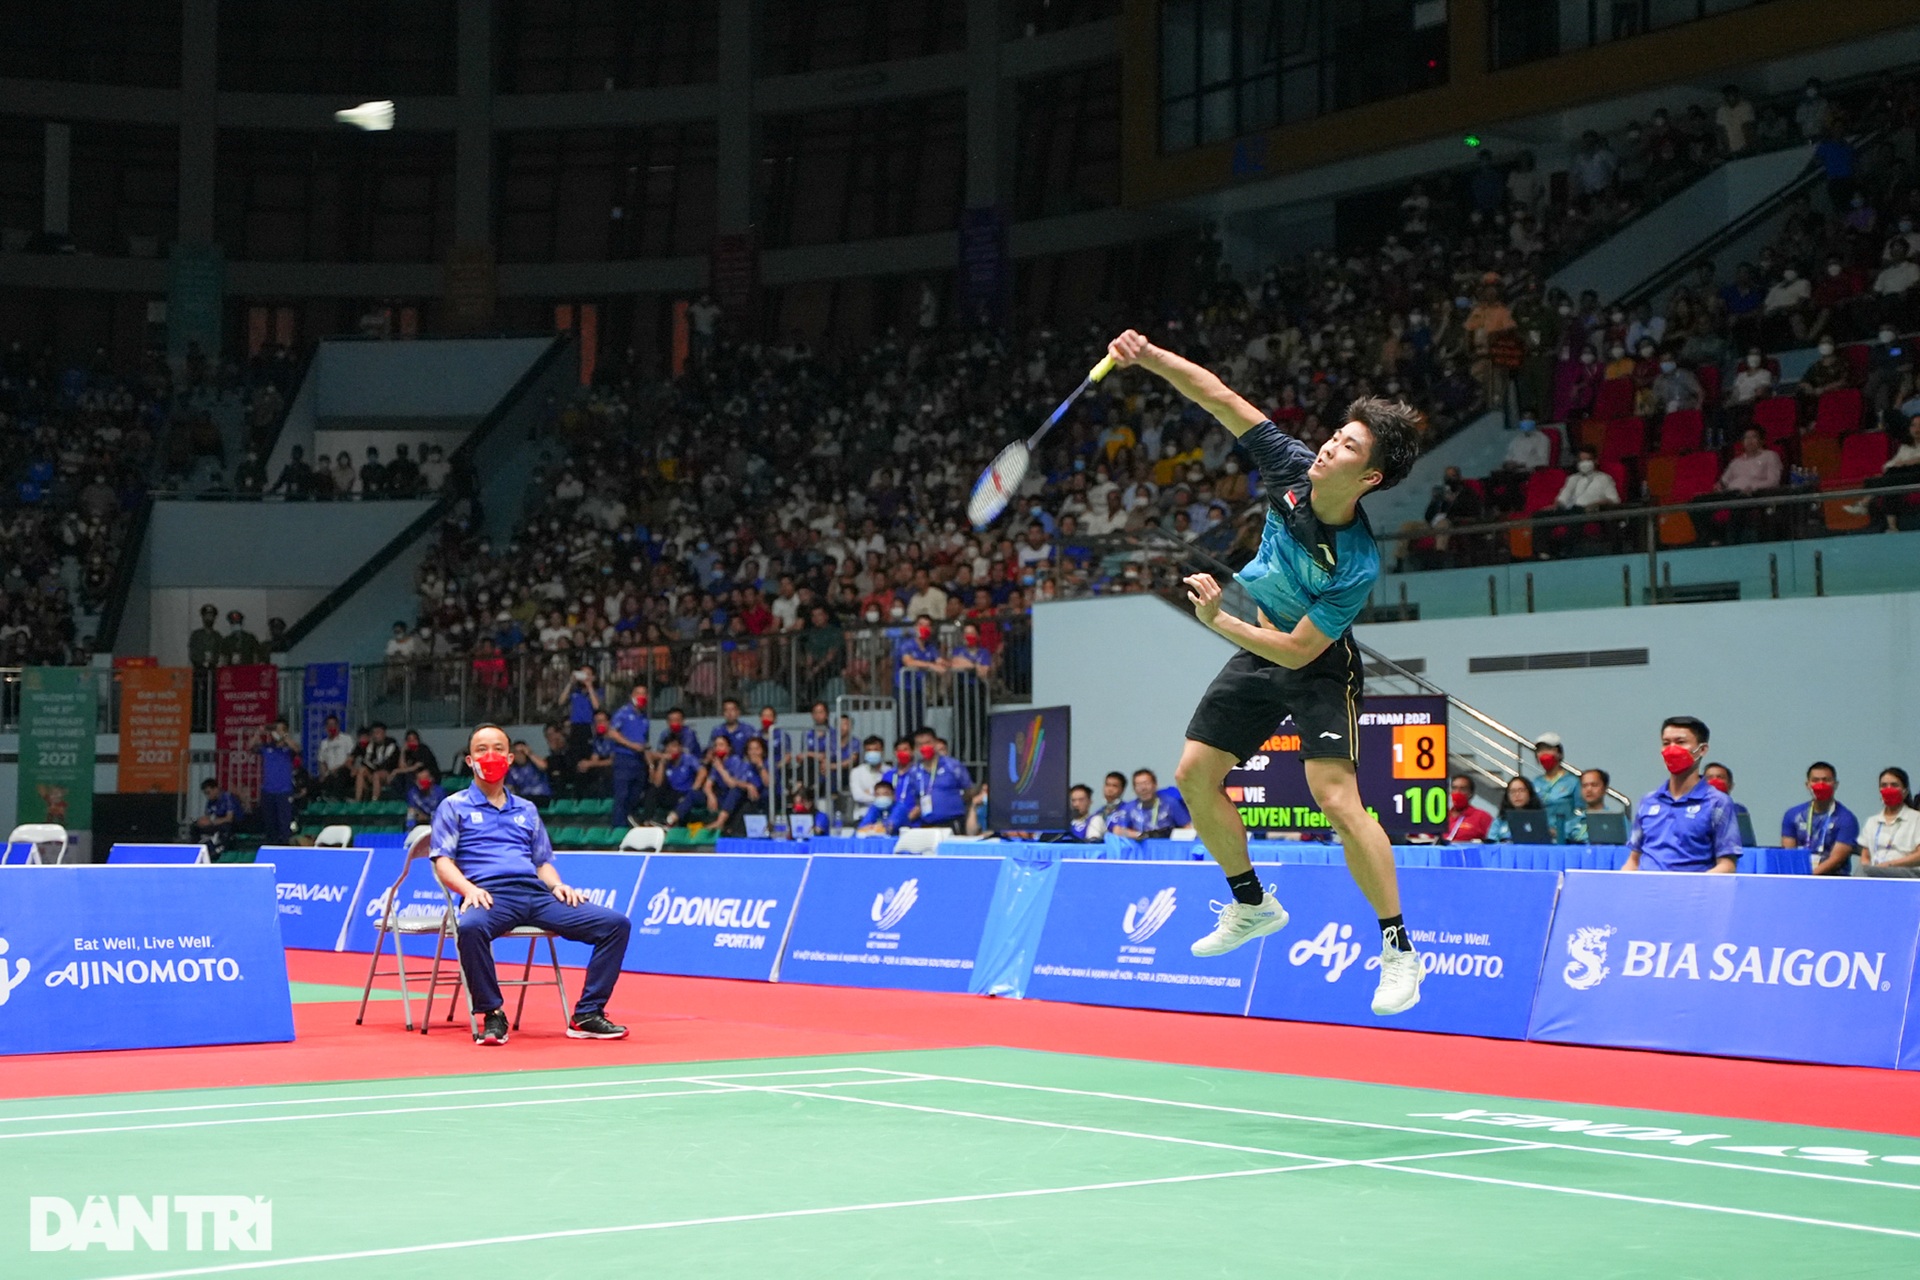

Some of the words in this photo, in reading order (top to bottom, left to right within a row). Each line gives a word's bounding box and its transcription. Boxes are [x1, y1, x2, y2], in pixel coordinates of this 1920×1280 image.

[1376, 713, 1403, 725] NAM
[1404, 712, 1431, 725] 2021
[39, 752, 77, 766] 2021
[136, 750, 173, 763] 2021
[1393, 744, 1403, 763] 1
[1416, 736, 1434, 770] 8
[1243, 755, 1270, 771] SGP
[1243, 787, 1266, 803] VIE
[1393, 794, 1404, 814] 1
[1405, 786, 1447, 824] 10
[666, 896, 778, 929] DONGLUC
[74, 938, 99, 951] Eat
[103, 936, 140, 951] Well,
[143, 936, 175, 950] Live
[178, 935, 215, 949] Well.
[713, 932, 767, 950] SPORT.VN
[1411, 929, 1437, 944] Well,
[1439, 930, 1463, 945] Live
[1464, 932, 1491, 946] Well.
[44, 957, 240, 990] AJINOMOTO
[1622, 940, 1701, 980] BIA
[1709, 943, 1887, 991] SAIGON
[1406, 1109, 1732, 1147] YONEX
